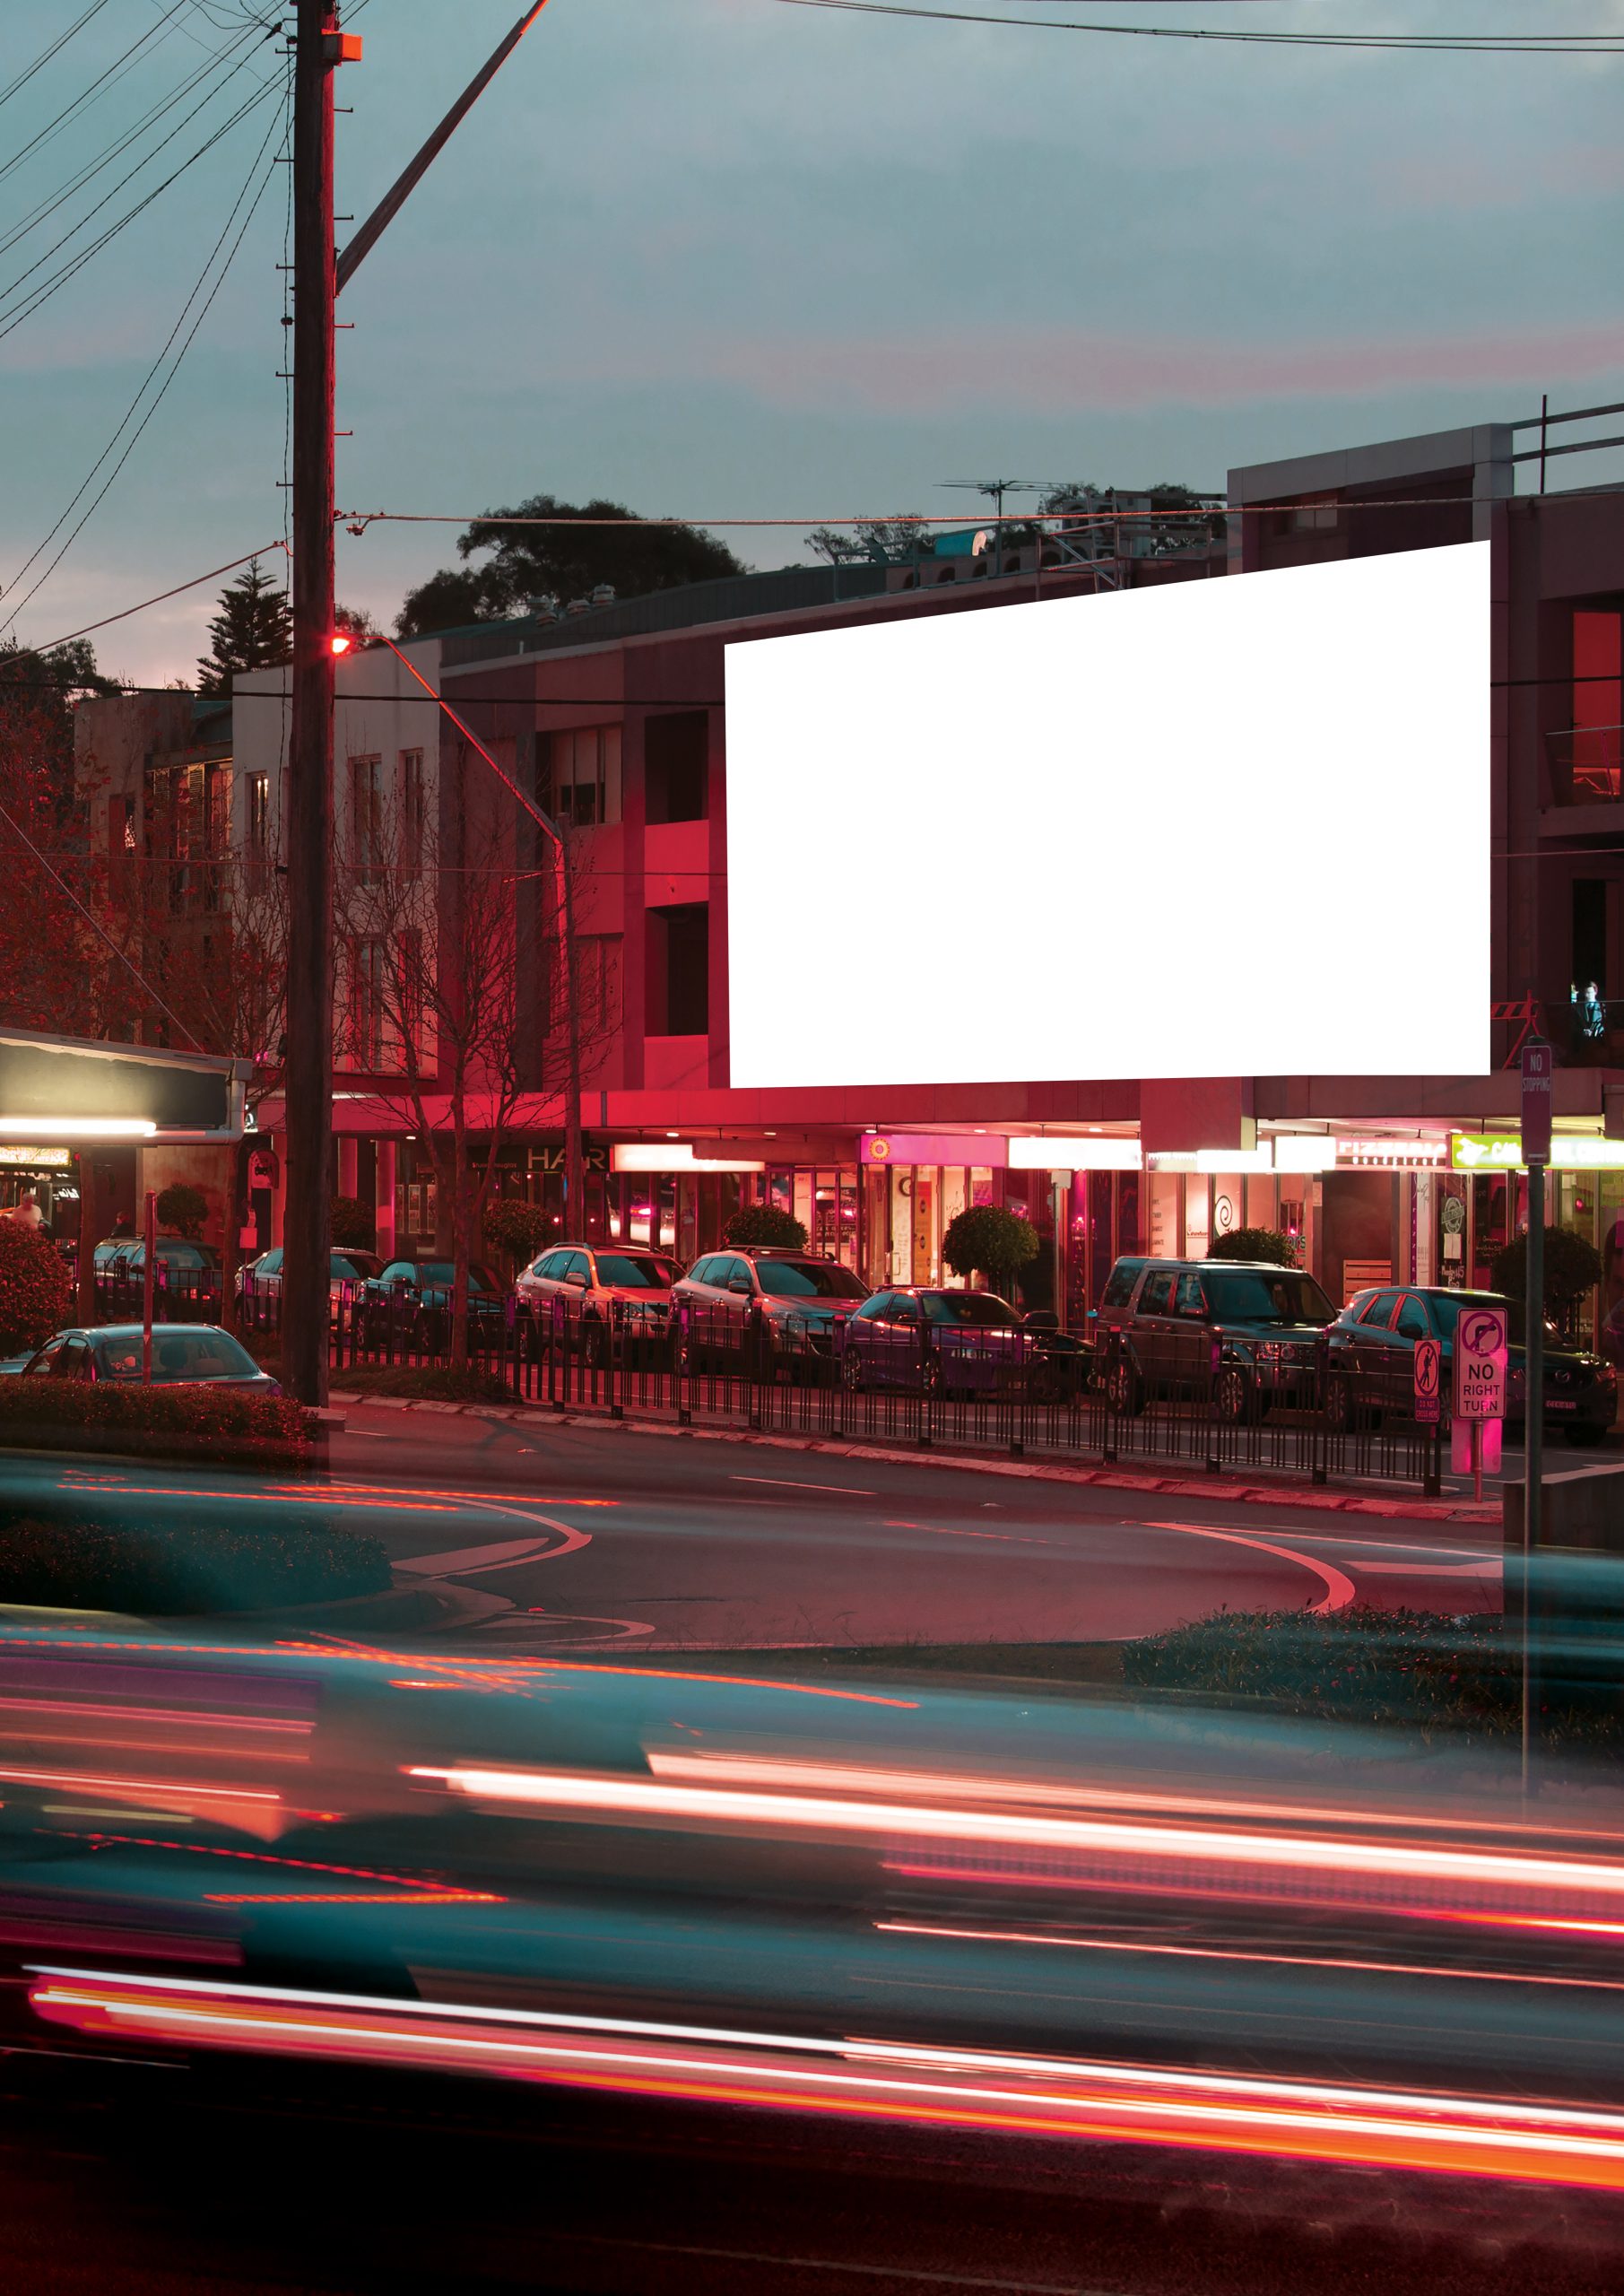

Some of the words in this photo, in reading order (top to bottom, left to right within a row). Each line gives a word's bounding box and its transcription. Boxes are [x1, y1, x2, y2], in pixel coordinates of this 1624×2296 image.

[1530, 1055, 1542, 1072] NO
[1523, 1077, 1550, 1091] STOPPING
[528, 1148, 605, 1170] HAR
[1468, 1364, 1494, 1380] NO
[1463, 1385, 1500, 1396] RIGHT
[1463, 1401, 1498, 1412] TURN
